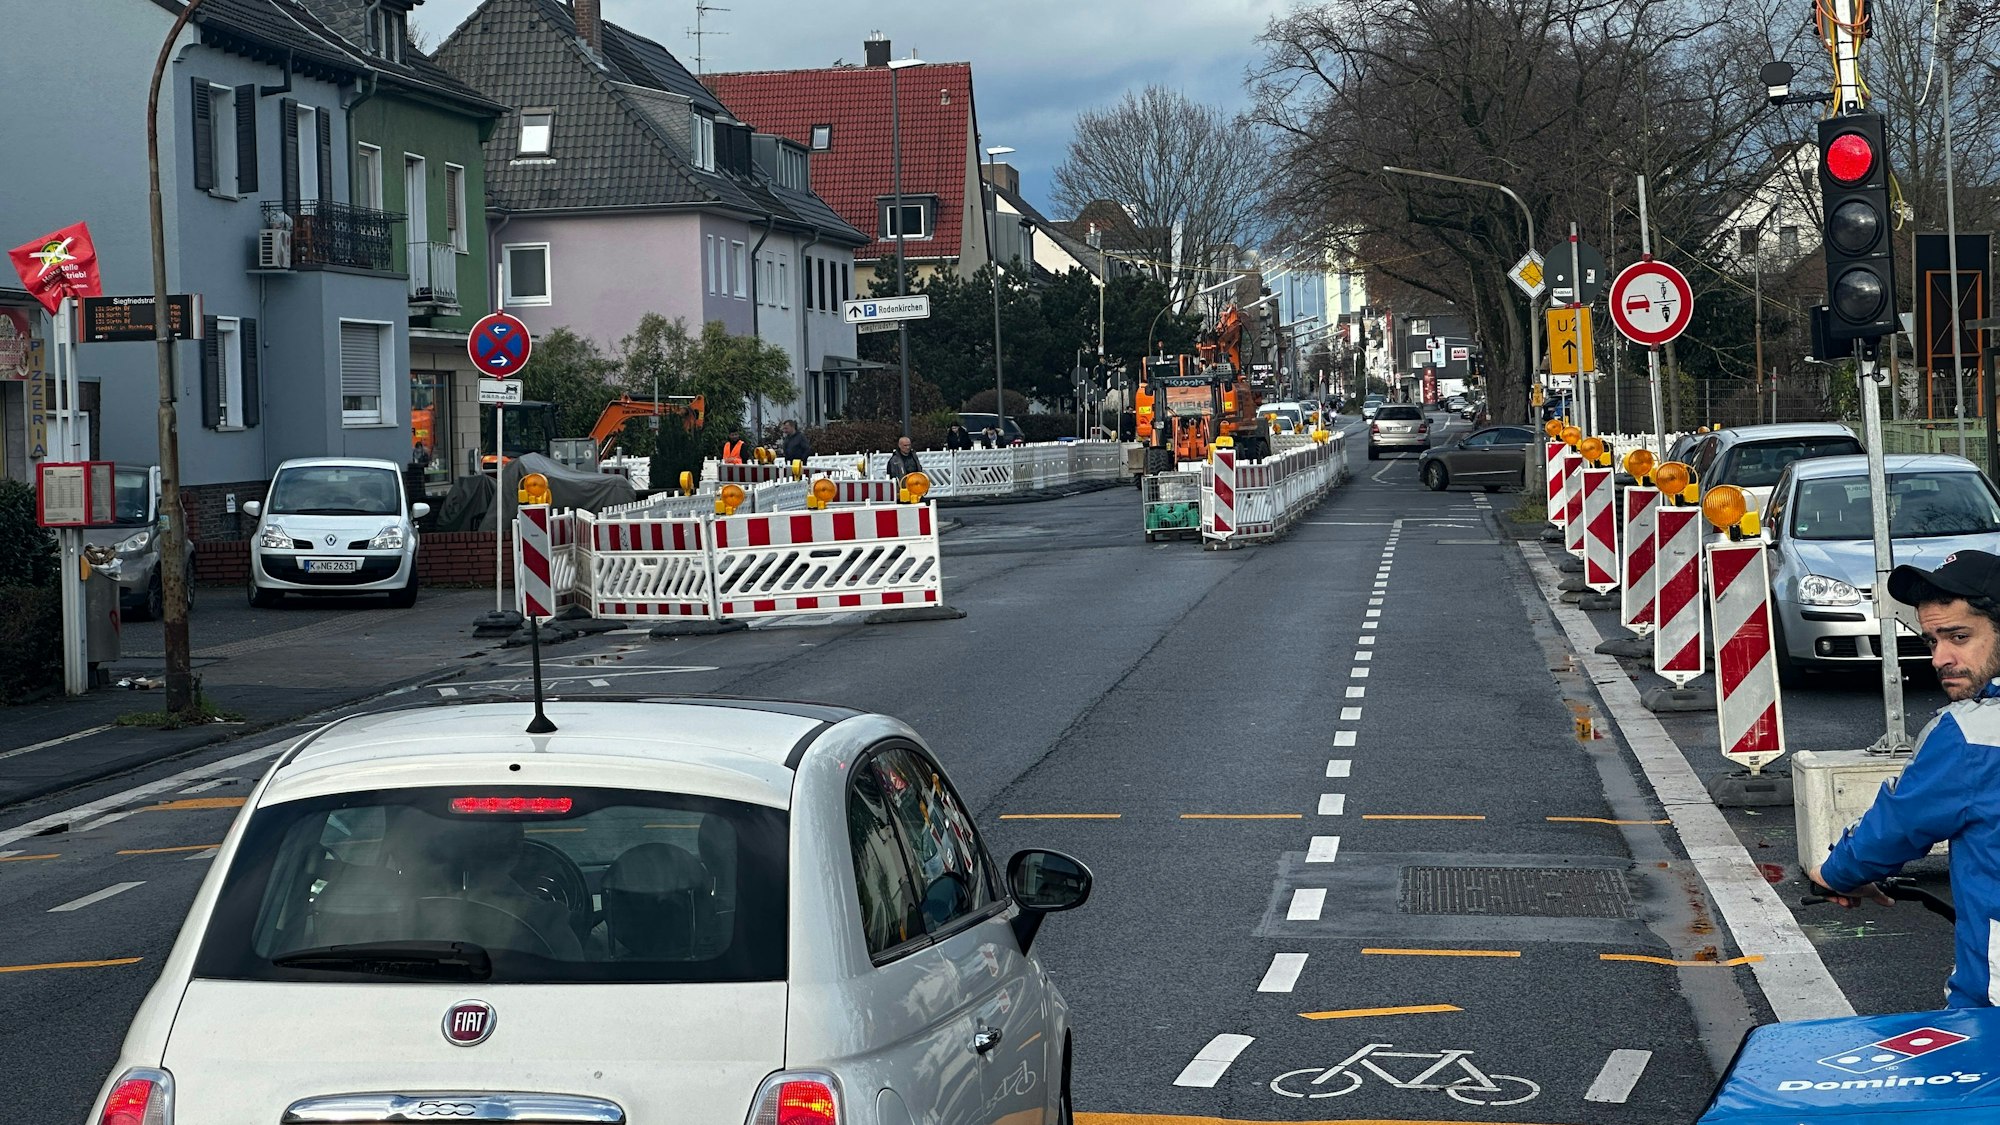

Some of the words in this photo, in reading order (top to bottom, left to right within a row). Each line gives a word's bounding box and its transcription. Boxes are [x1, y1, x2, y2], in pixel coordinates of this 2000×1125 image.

[878, 303, 923, 314] Rodenkirchen
[860, 323, 896, 332] Siegfriedstr.
[1169, 379, 1205, 387] Kubota
[30, 341, 45, 454] PIZZERIA
[310, 562, 316, 570] K
[320, 562, 332, 570] NG
[334, 562, 354, 570] 2631
[454, 1011, 486, 1032] FIAT
[1777, 1072, 1980, 1091] Domino's
[417, 1100, 477, 1116] 500
